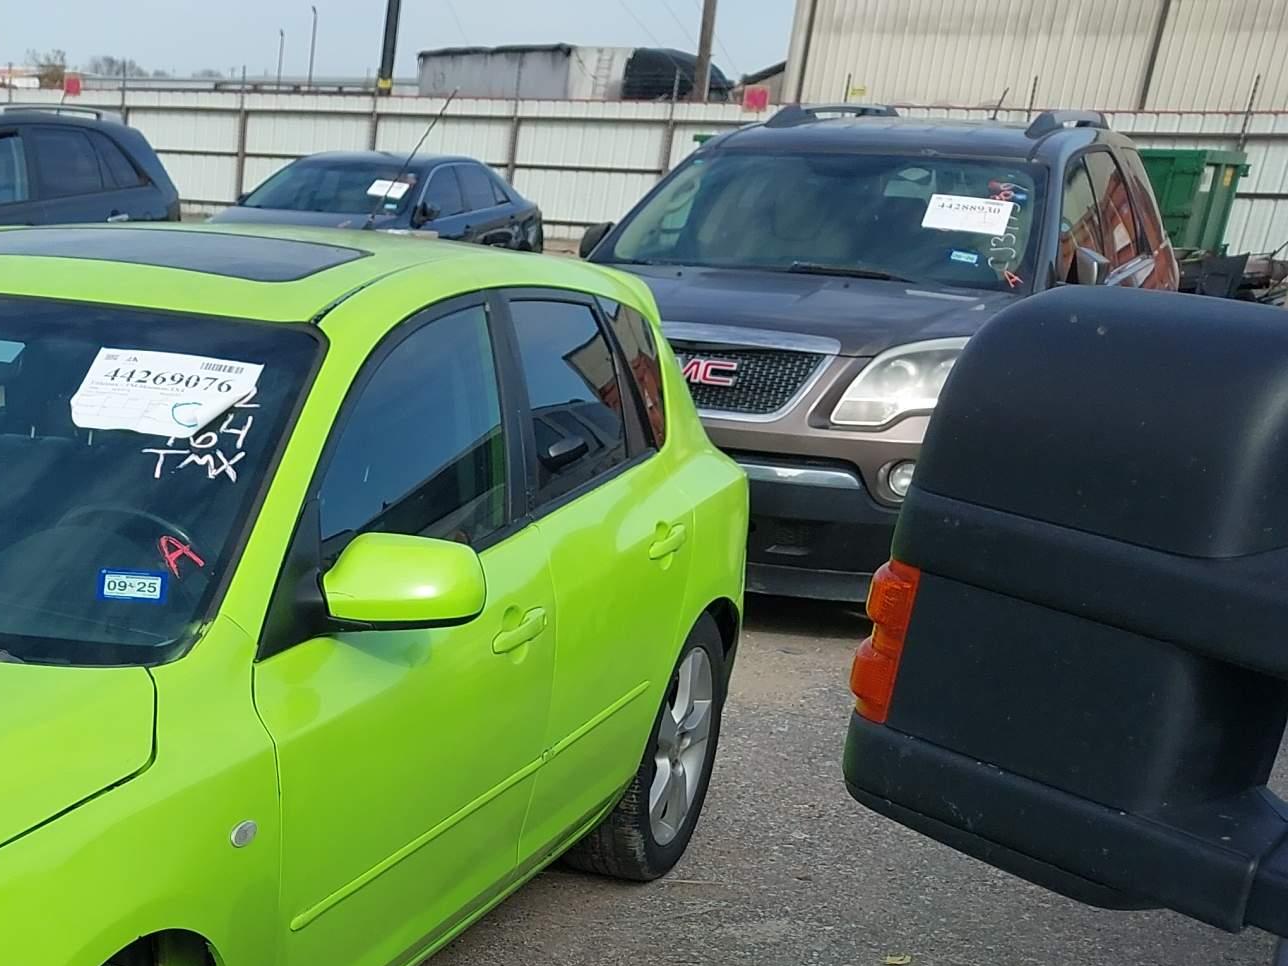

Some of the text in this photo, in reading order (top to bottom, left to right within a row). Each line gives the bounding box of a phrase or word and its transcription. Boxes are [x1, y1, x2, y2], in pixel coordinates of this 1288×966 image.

[937, 202, 1001, 215] 44288930
[104, 367, 235, 393] 44269076
[681, 358, 738, 387] MC
[158, 535, 205, 580] A
